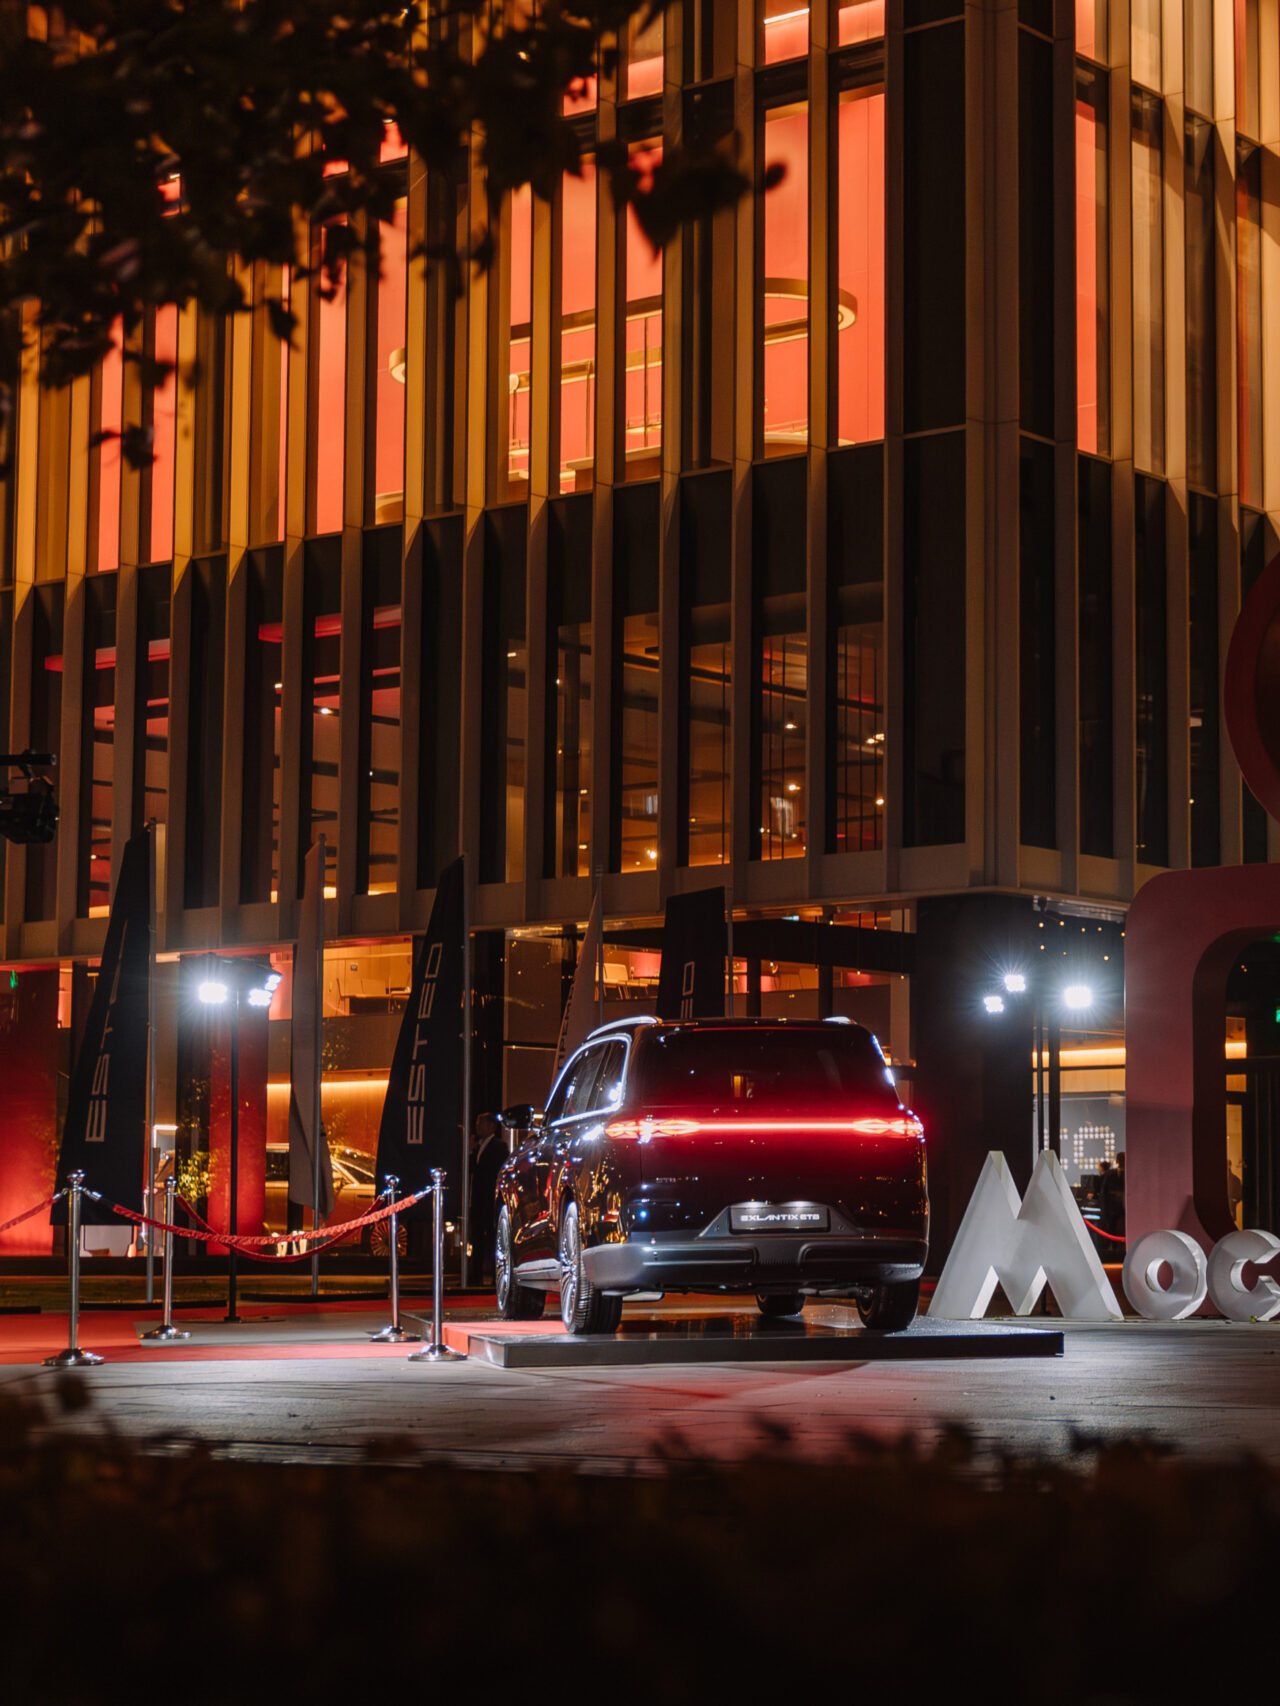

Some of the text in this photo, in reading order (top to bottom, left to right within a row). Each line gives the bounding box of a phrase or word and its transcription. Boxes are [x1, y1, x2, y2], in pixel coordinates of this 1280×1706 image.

[85, 919, 128, 1142] EST
[407, 943, 443, 1145] ESTEO
[740, 1213, 799, 1222] EXLANTIX
